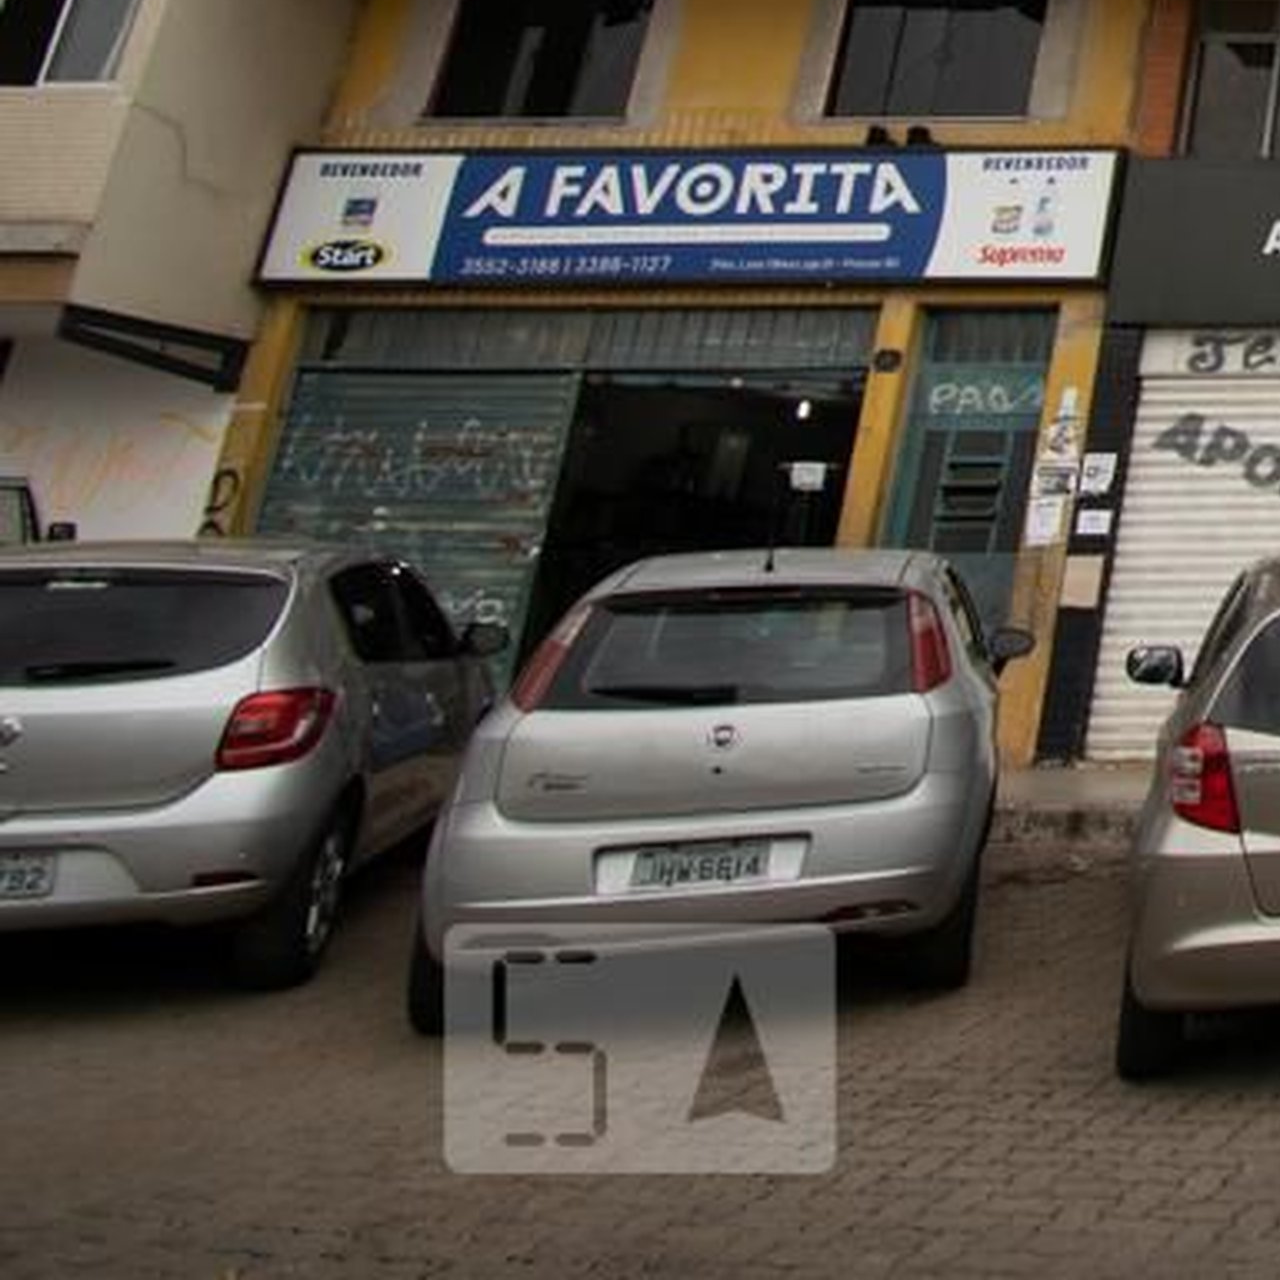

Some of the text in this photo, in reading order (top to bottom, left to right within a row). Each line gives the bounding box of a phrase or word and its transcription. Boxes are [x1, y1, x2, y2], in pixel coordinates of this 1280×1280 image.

[463, 161, 922, 218] A FAVORITA
[317, 246, 378, 267] Start
